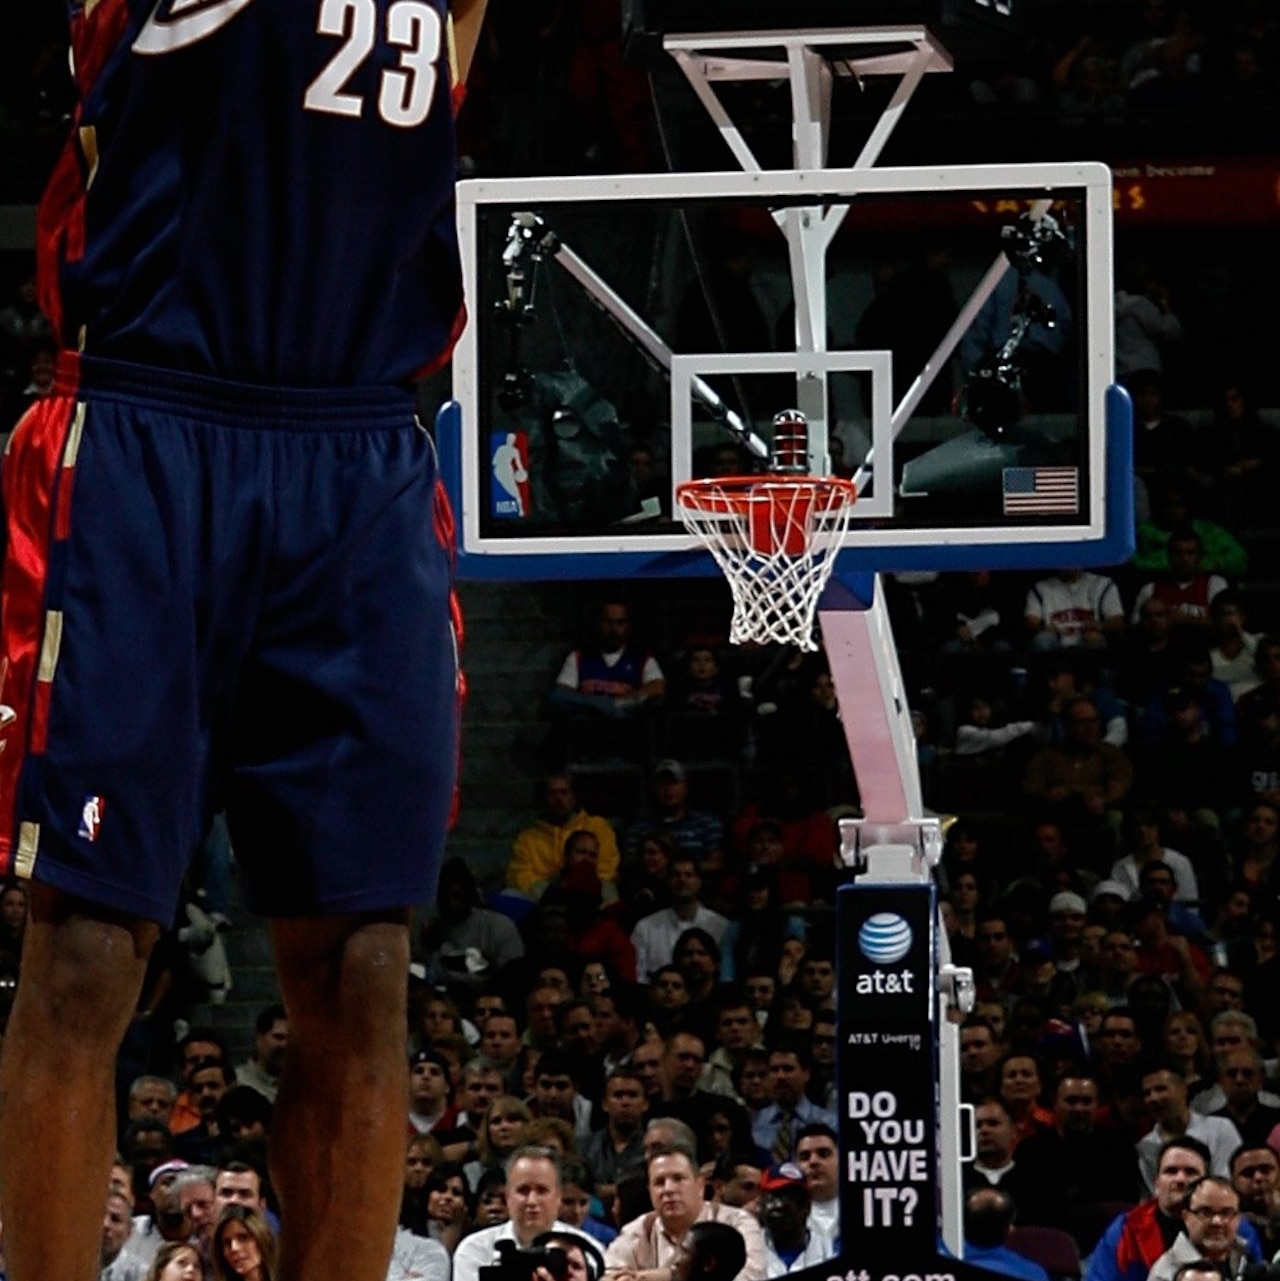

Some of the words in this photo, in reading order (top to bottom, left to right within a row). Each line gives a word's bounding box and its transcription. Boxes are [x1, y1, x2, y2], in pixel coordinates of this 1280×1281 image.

[856, 969, 914, 994] at&t
[848, 1032, 878, 1045] AT&T
[848, 1091, 897, 1118] DO
[859, 1121, 924, 1145] YOU
[848, 1151, 927, 1182] HAVE
[863, 1188, 919, 1227] IT?
